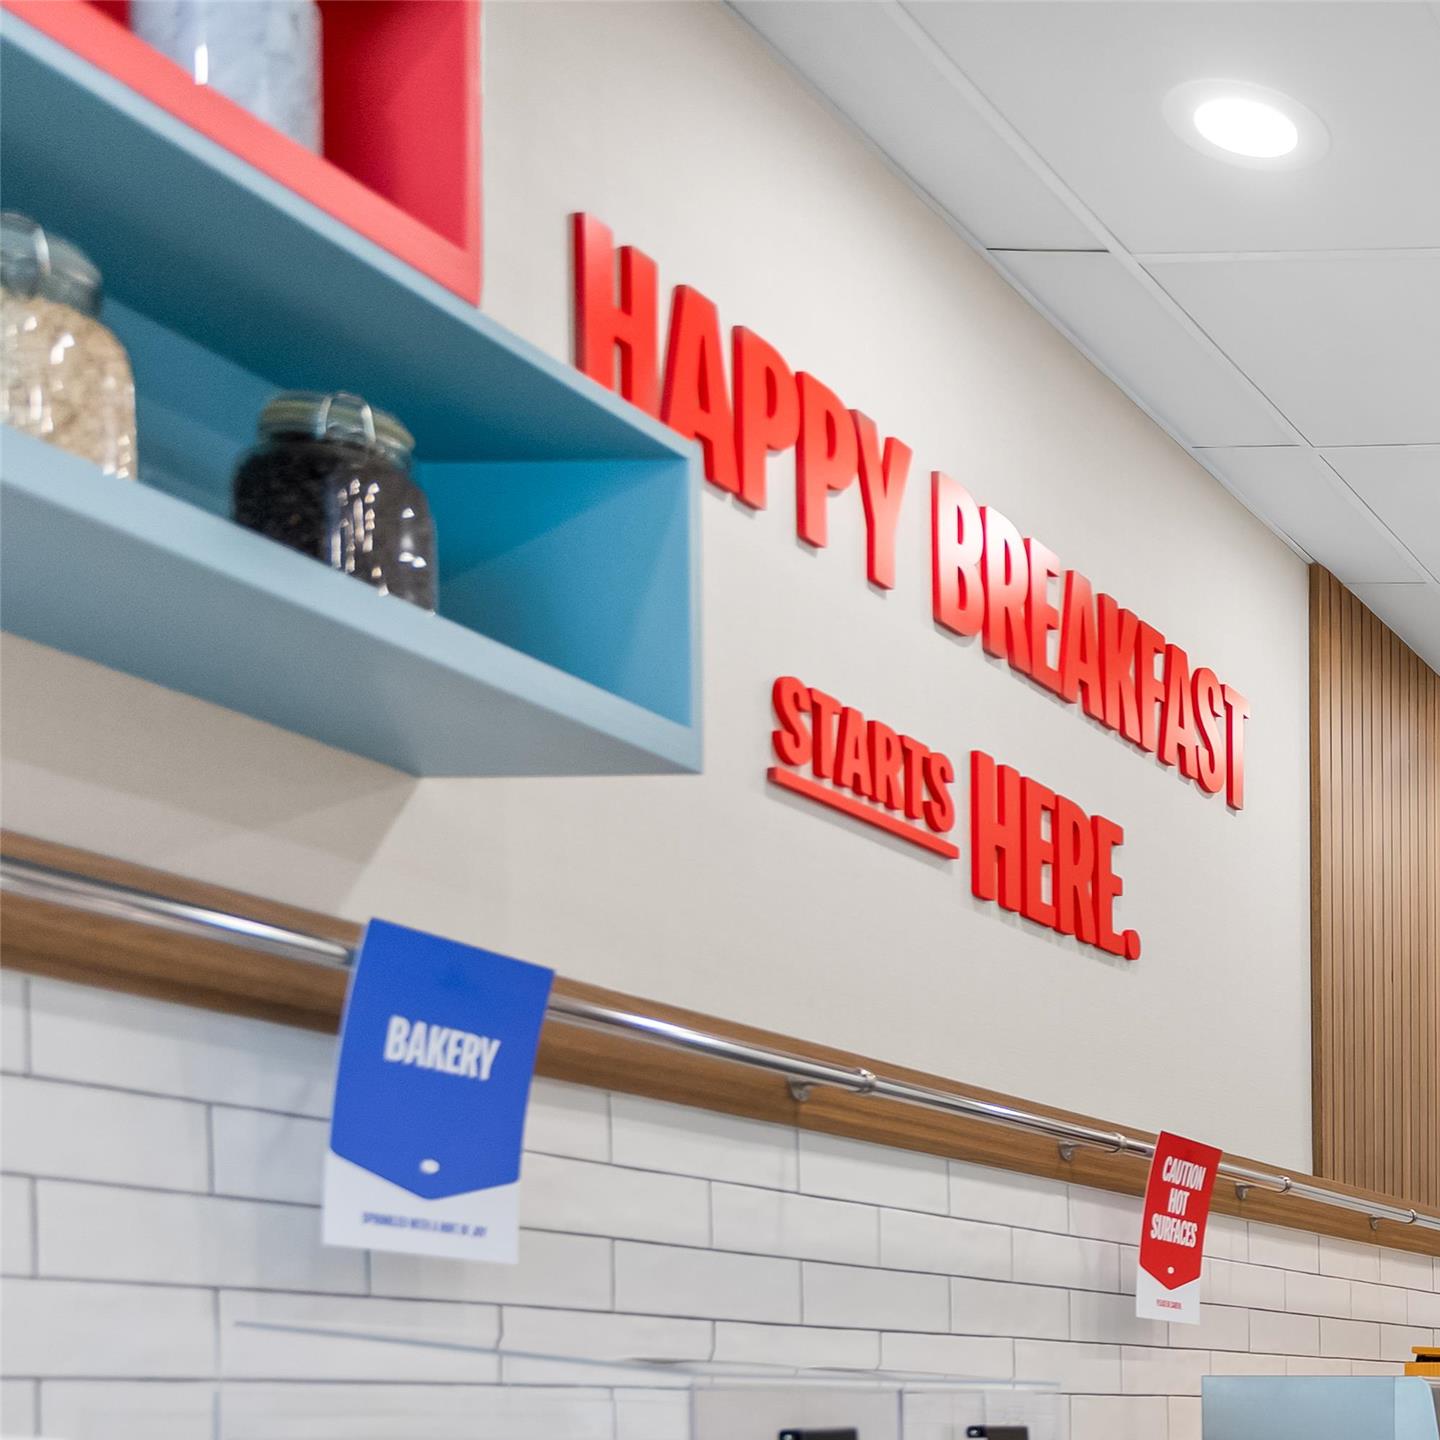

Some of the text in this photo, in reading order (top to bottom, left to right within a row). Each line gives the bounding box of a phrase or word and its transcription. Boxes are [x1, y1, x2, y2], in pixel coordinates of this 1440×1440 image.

[570, 212, 1251, 810] HAPPY BREAKFAST
[771, 676, 1142, 961] STARTS HERE.
[383, 1013, 501, 1082] BAKERY
[1163, 1157, 1207, 1191] CAUTION
[1168, 1188, 1189, 1216] HOT
[1151, 1214, 1198, 1248] SURFACES
